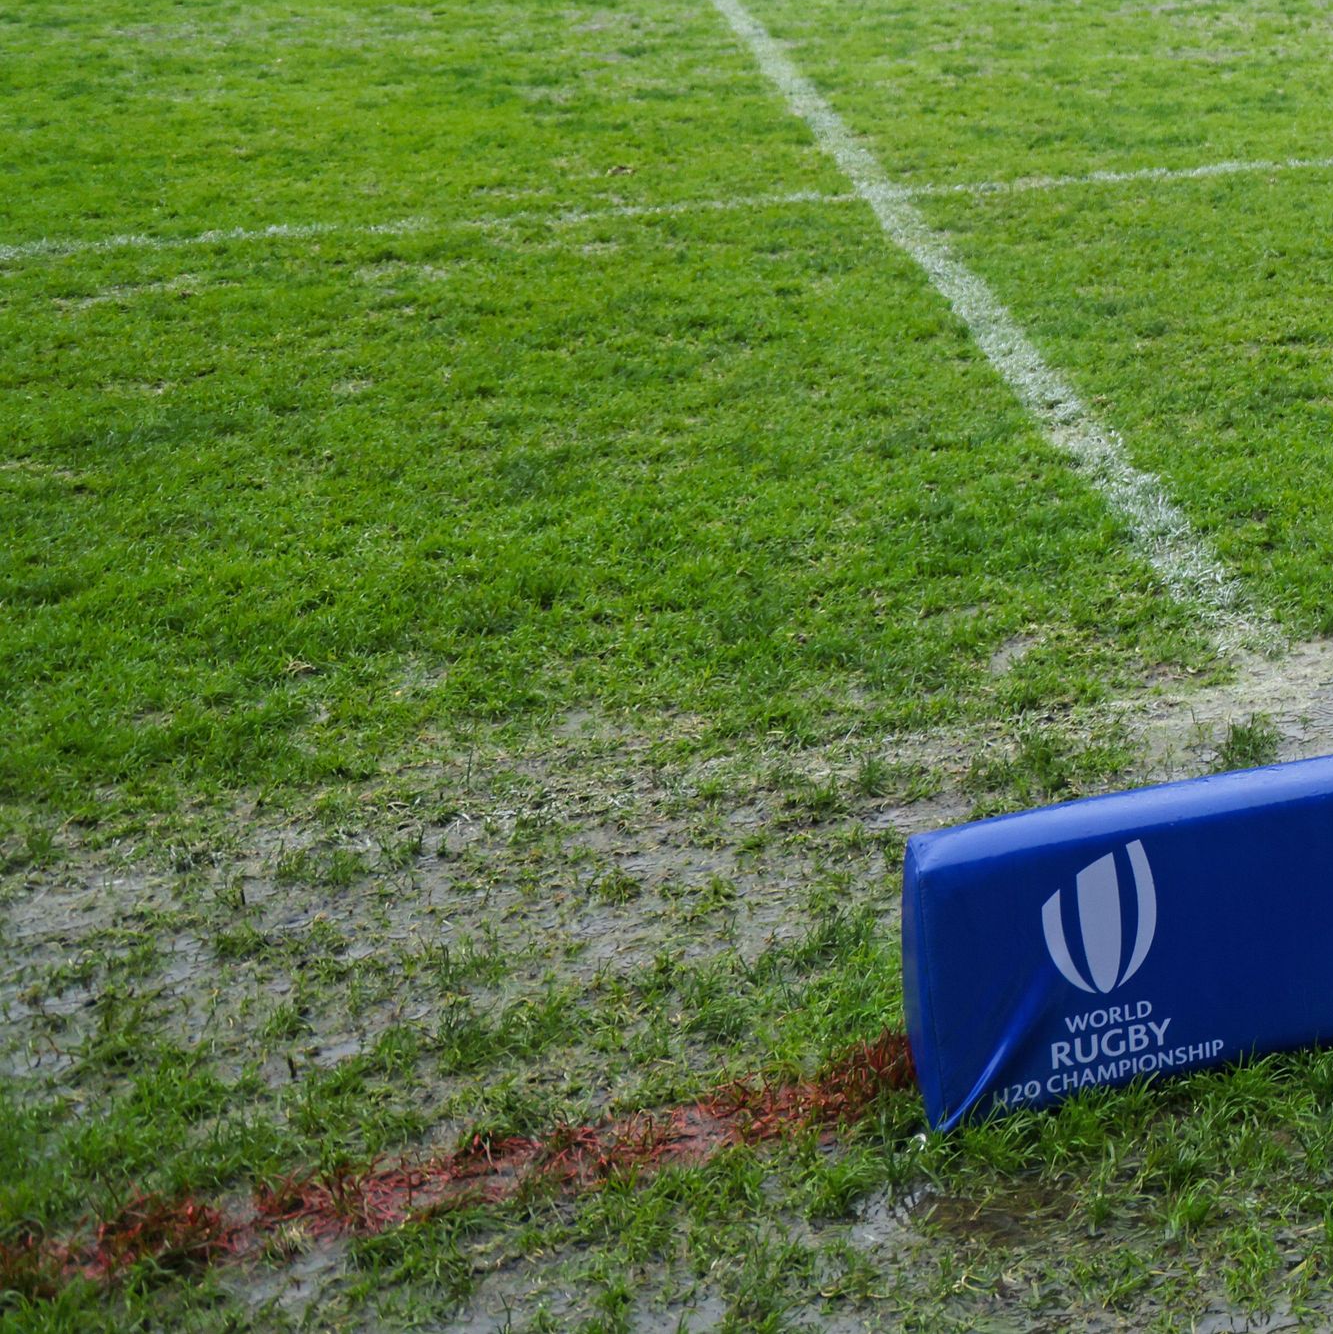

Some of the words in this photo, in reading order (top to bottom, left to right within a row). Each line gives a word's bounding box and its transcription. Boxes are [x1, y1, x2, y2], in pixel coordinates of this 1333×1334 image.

[1064, 1000, 1152, 1033] WORLD
[1046, 1039, 1224, 1094] CHAMPIONSHIP
[1050, 1018, 1171, 1070] RUGBY
